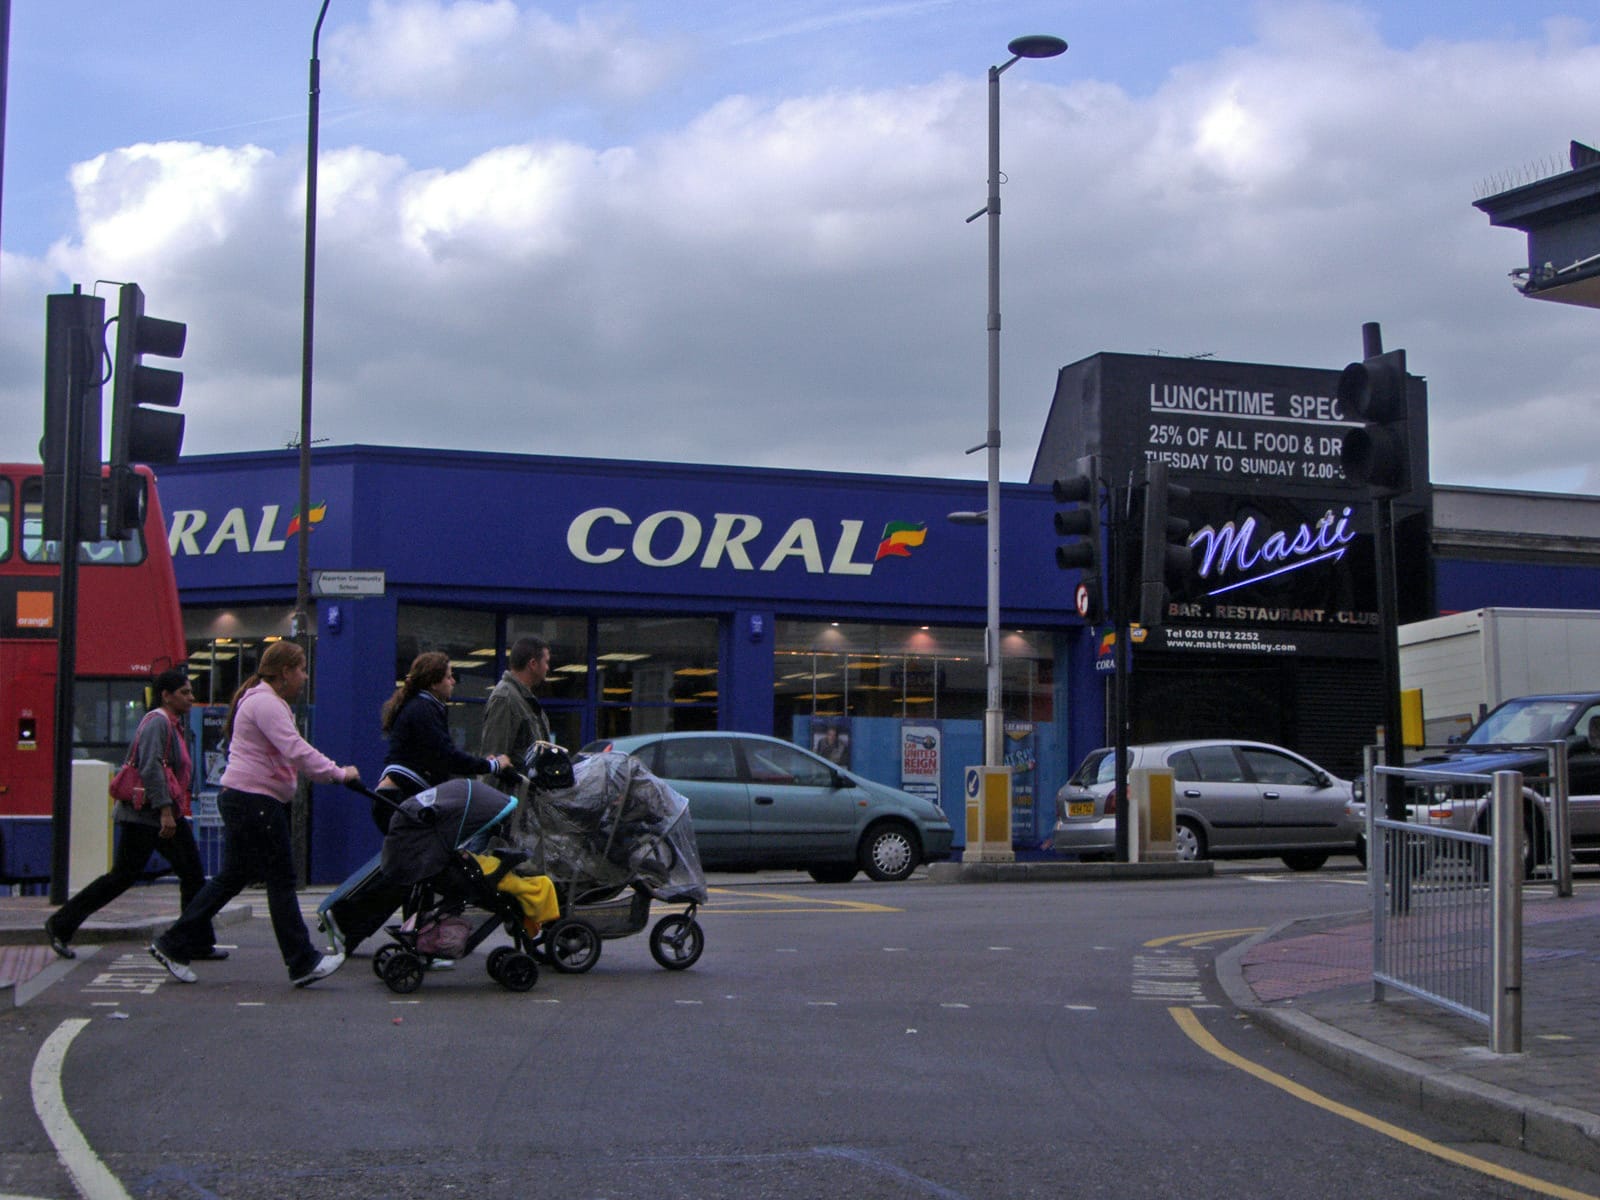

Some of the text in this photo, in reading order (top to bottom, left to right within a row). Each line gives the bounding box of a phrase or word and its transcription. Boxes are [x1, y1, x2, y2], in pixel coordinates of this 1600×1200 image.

[1150, 383, 1345, 421] LUNCHTIME SPEC
[1149, 424, 1343, 456] 25% OF ALL FOOD & DR
[1214, 455, 1234, 472] TO
[1240, 458, 1295, 477] SUNDAY
[168, 504, 286, 557] RAL
[566, 506, 874, 576] CORAL
[1187, 506, 1356, 579] Masti
[18, 617, 50, 628] orange
[1168, 603, 1380, 625] BAR RESTAURANT CLUB
[1165, 629, 1259, 641] Tel 020 8782 2252
[1166, 639, 1297, 652] www.masti-wembley.com
[1096, 659, 1116, 670] CORA
[903, 750, 937, 758] UNITED
[903, 758, 937, 769] REIGN
